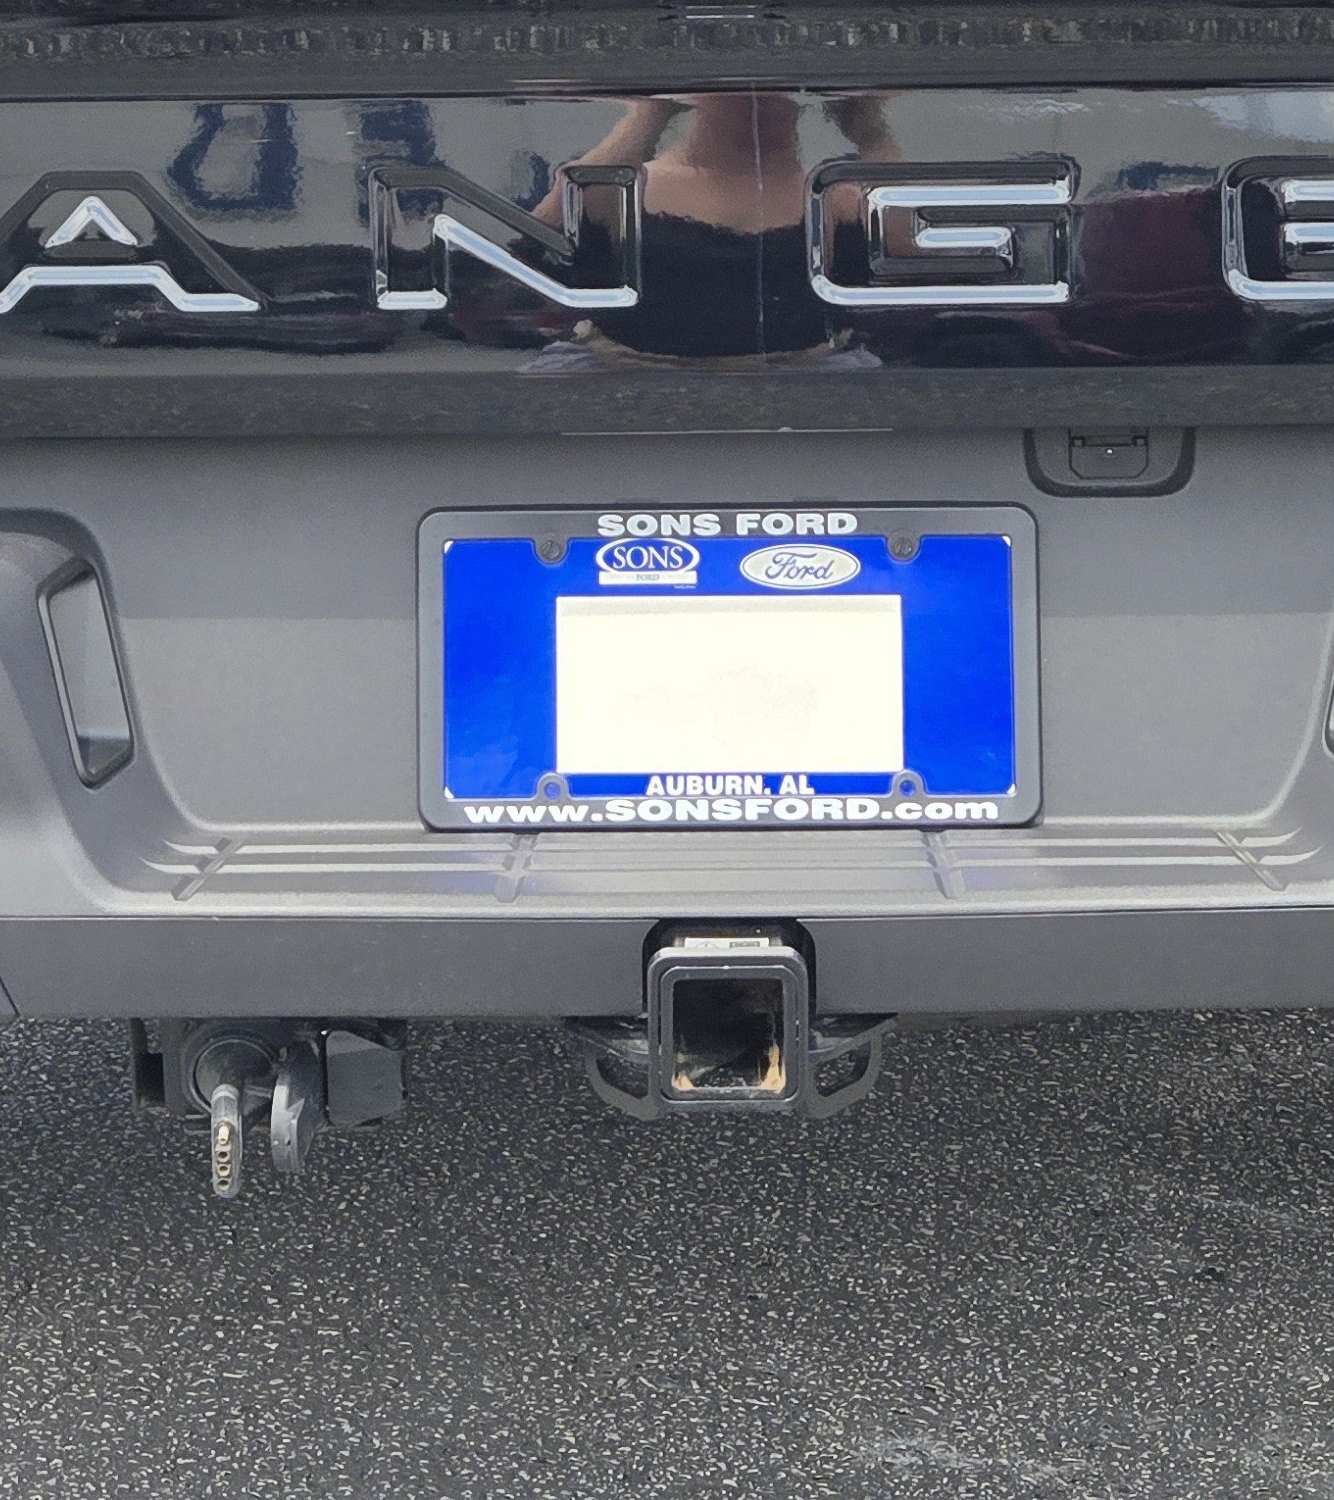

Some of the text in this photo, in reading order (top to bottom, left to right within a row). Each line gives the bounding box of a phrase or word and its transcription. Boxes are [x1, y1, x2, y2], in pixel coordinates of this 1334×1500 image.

[597, 513, 859, 537] SONS FORD
[612, 545, 684, 570] SONS
[765, 551, 835, 581] Ford
[635, 573, 660, 582] FORD
[779, 774, 815, 796] AL
[464, 797, 999, 823] www.SONSFORD.com
